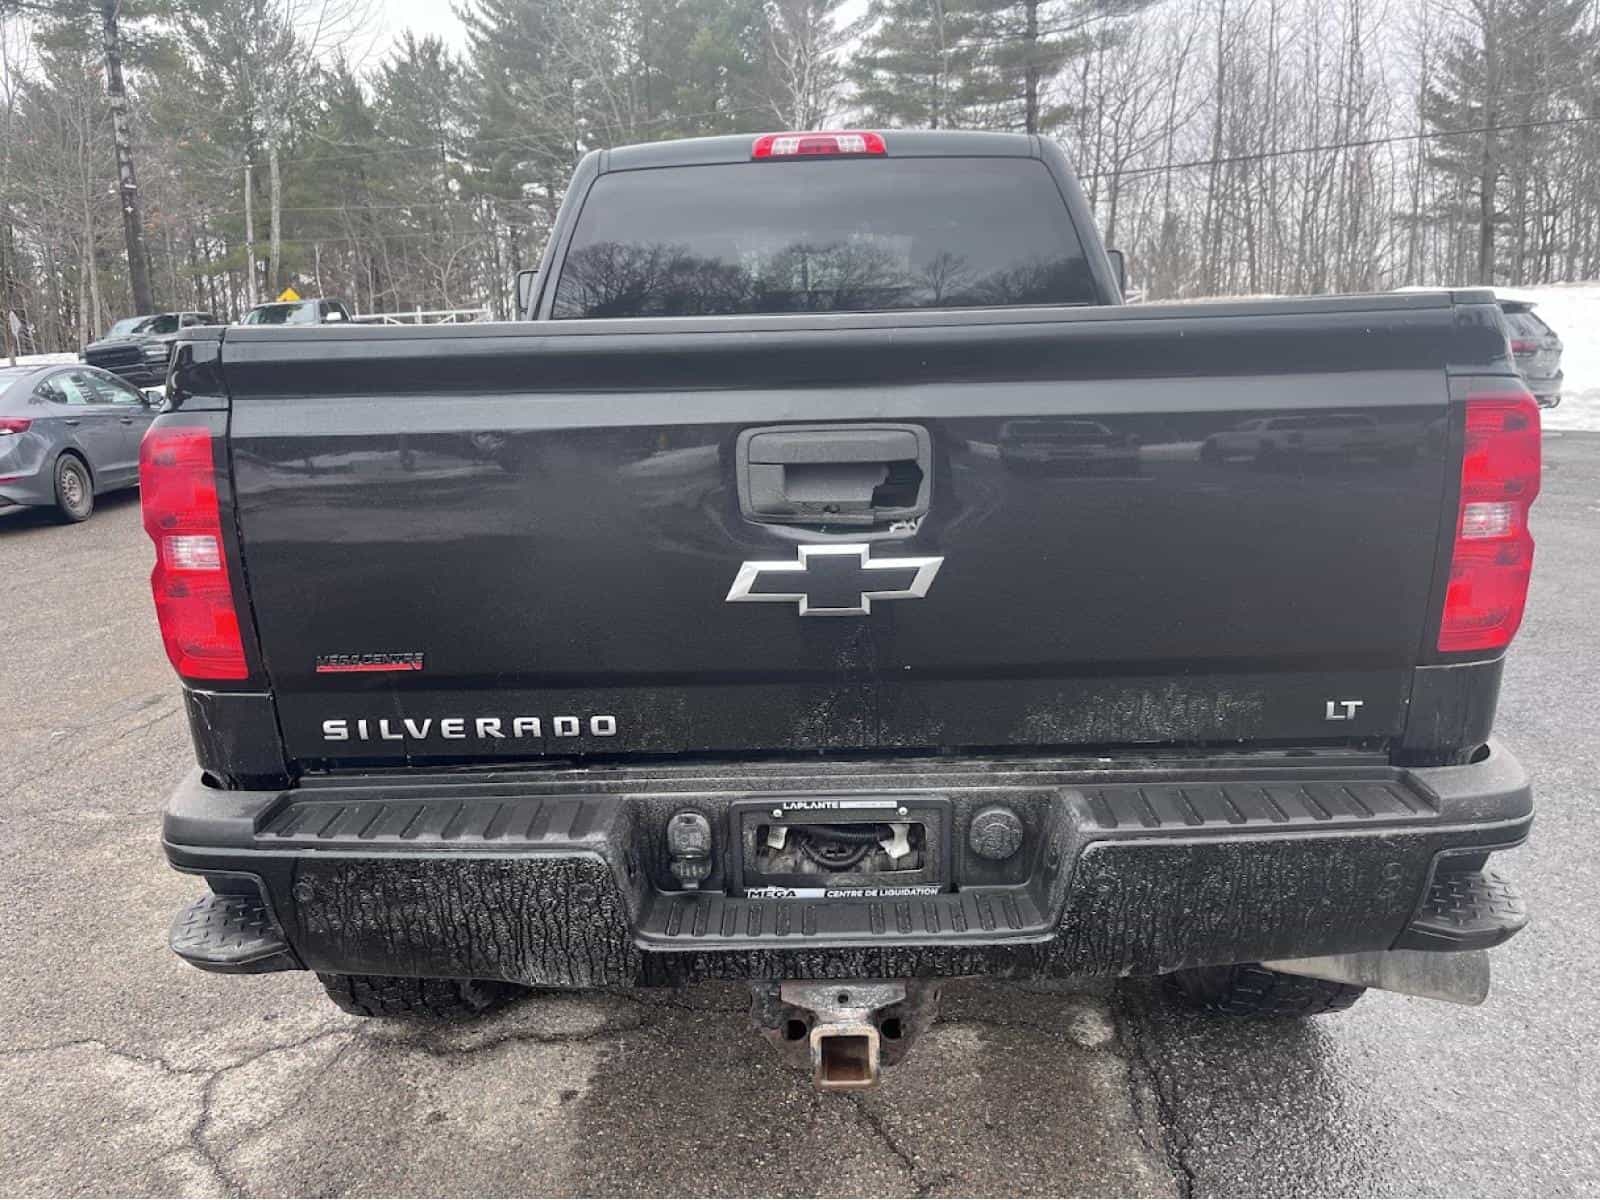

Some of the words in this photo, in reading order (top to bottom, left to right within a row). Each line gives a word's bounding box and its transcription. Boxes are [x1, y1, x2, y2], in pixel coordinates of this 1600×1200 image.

[1326, 701, 1363, 720] LT
[322, 715, 617, 740] SILVERADO
[783, 800, 839, 809] LAPLANTE
[826, 889, 863, 898] CENTRE
[865, 889, 878, 897] DE
[880, 887, 938, 896] LIQUIDATION
